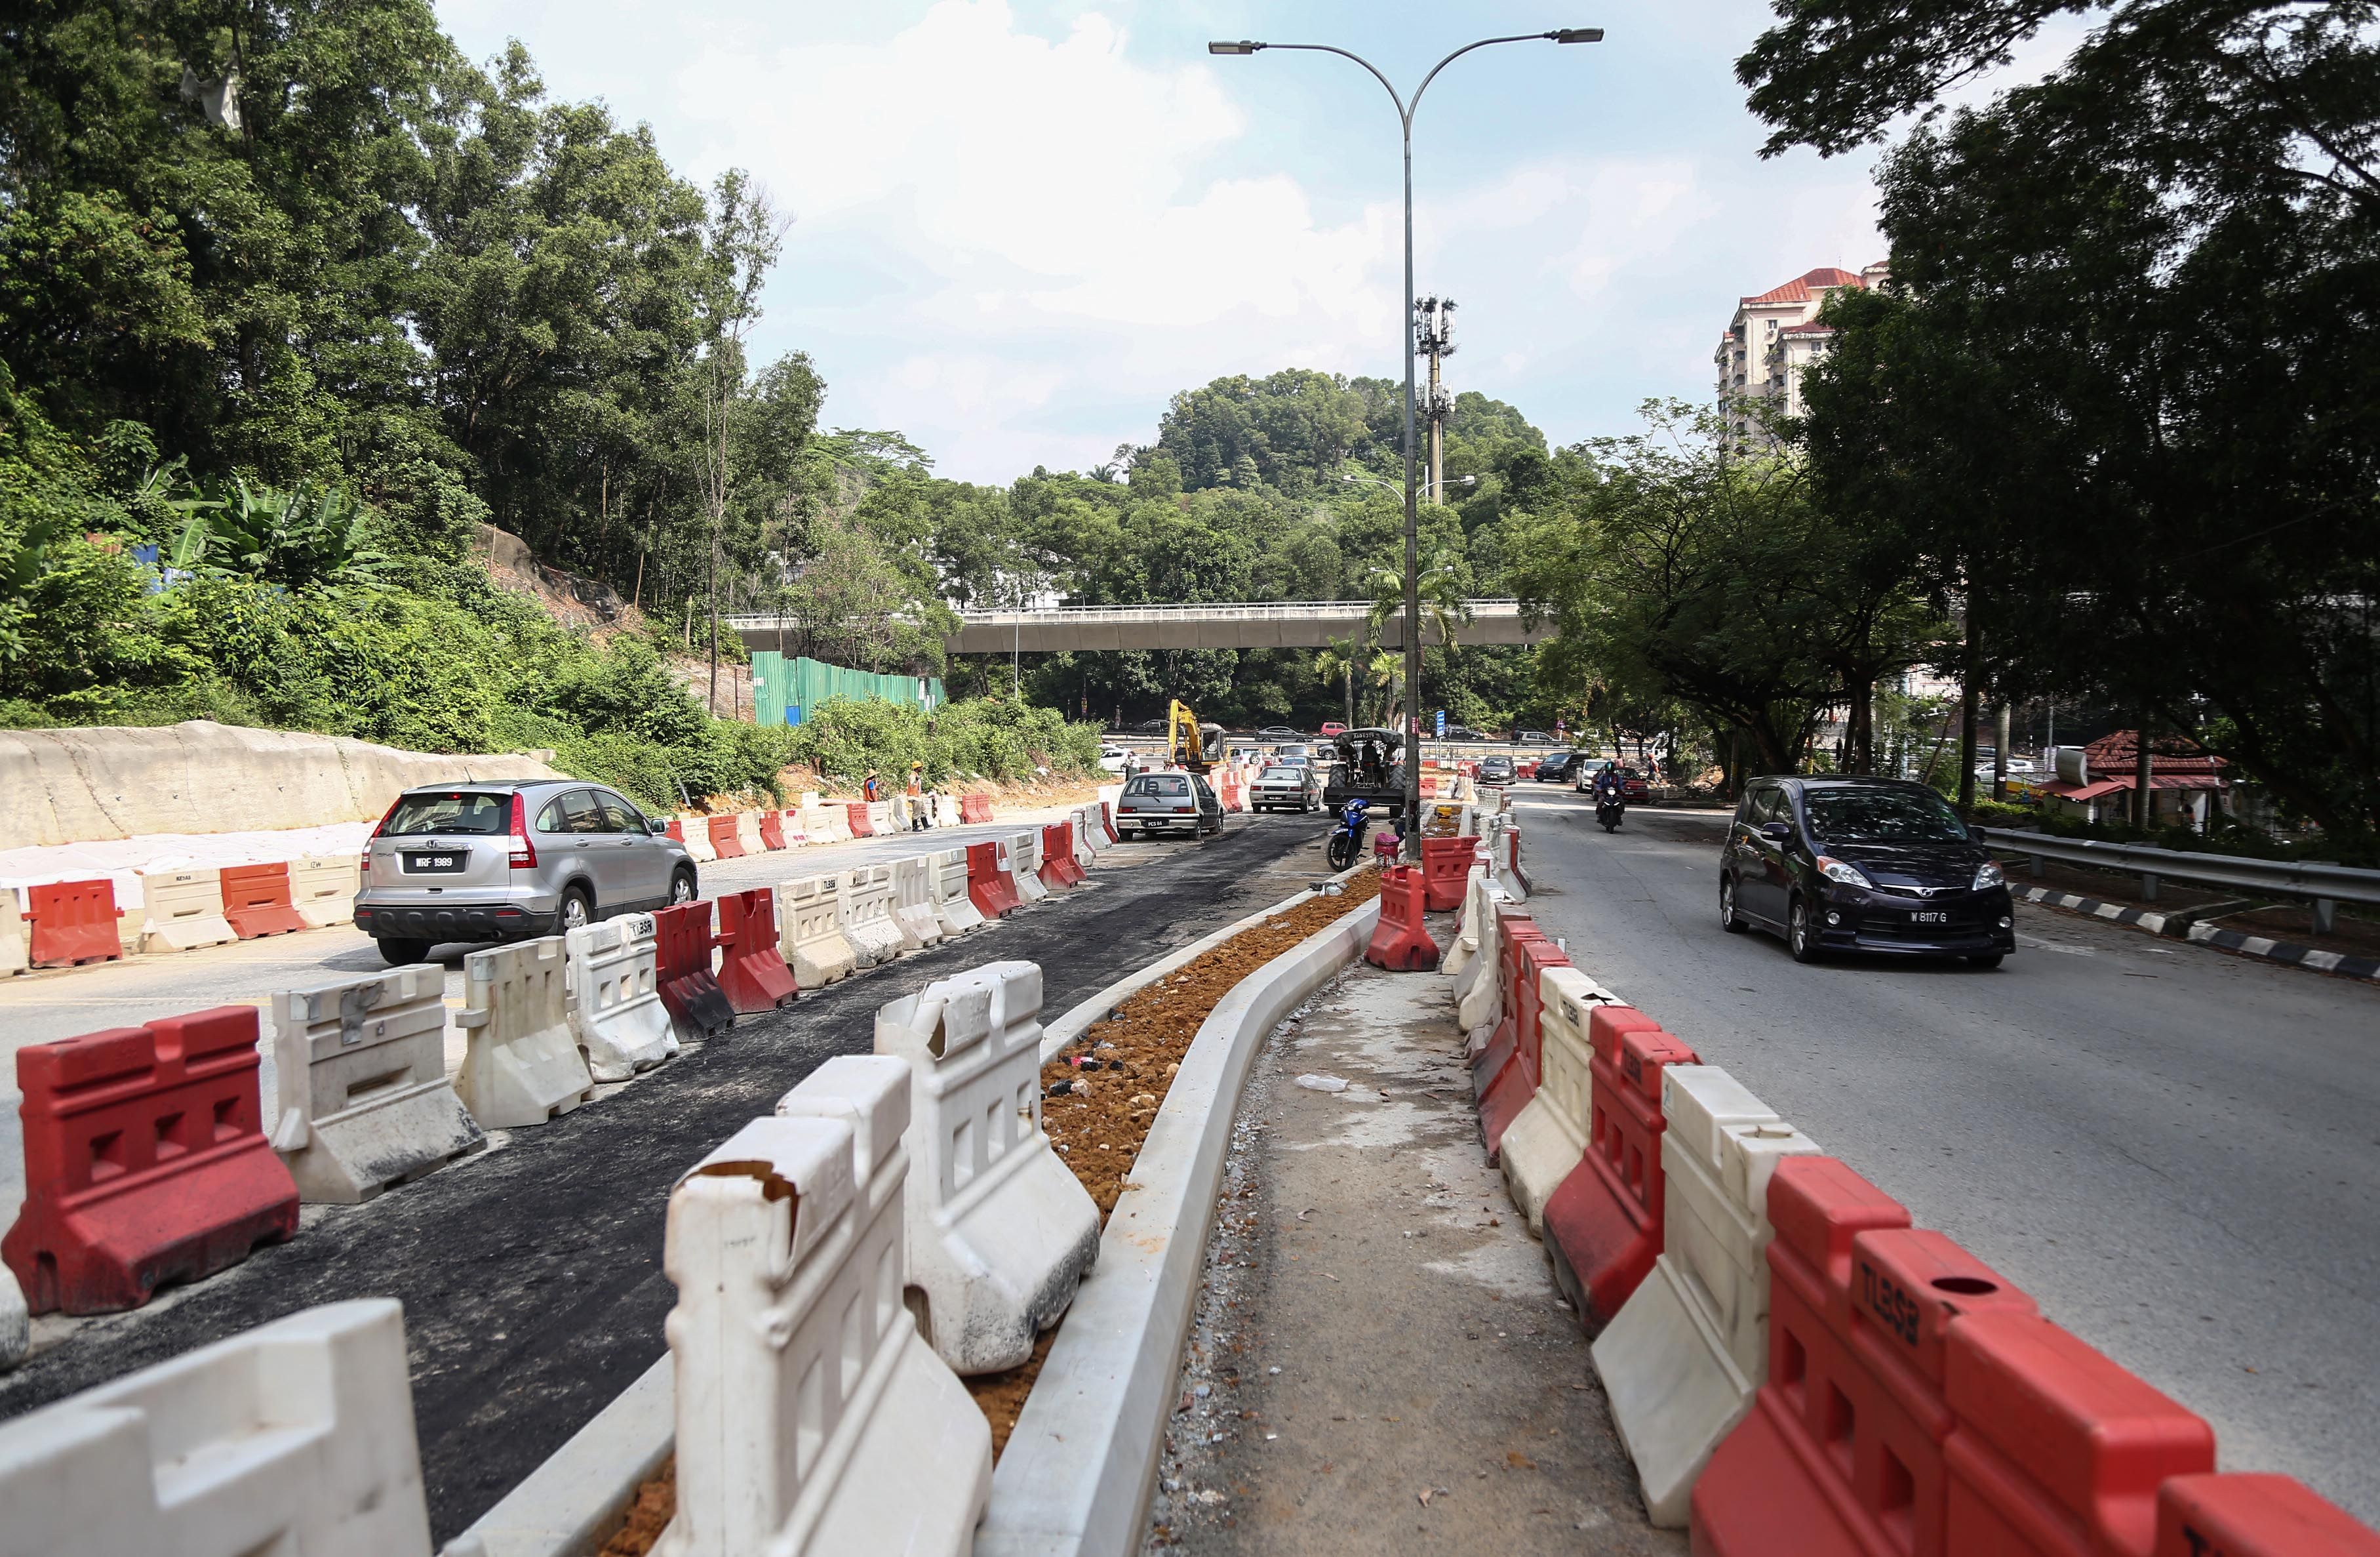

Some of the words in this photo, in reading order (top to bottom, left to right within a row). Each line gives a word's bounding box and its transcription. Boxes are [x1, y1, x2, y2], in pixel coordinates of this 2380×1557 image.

[416, 857, 431, 867] WRF
[433, 857, 452, 867] 1989
[1911, 912, 1918, 922] W
[1920, 912, 1939, 922] 8117
[1940, 912, 1947, 922] G
[1861, 1262, 1920, 1347] TLBSB
